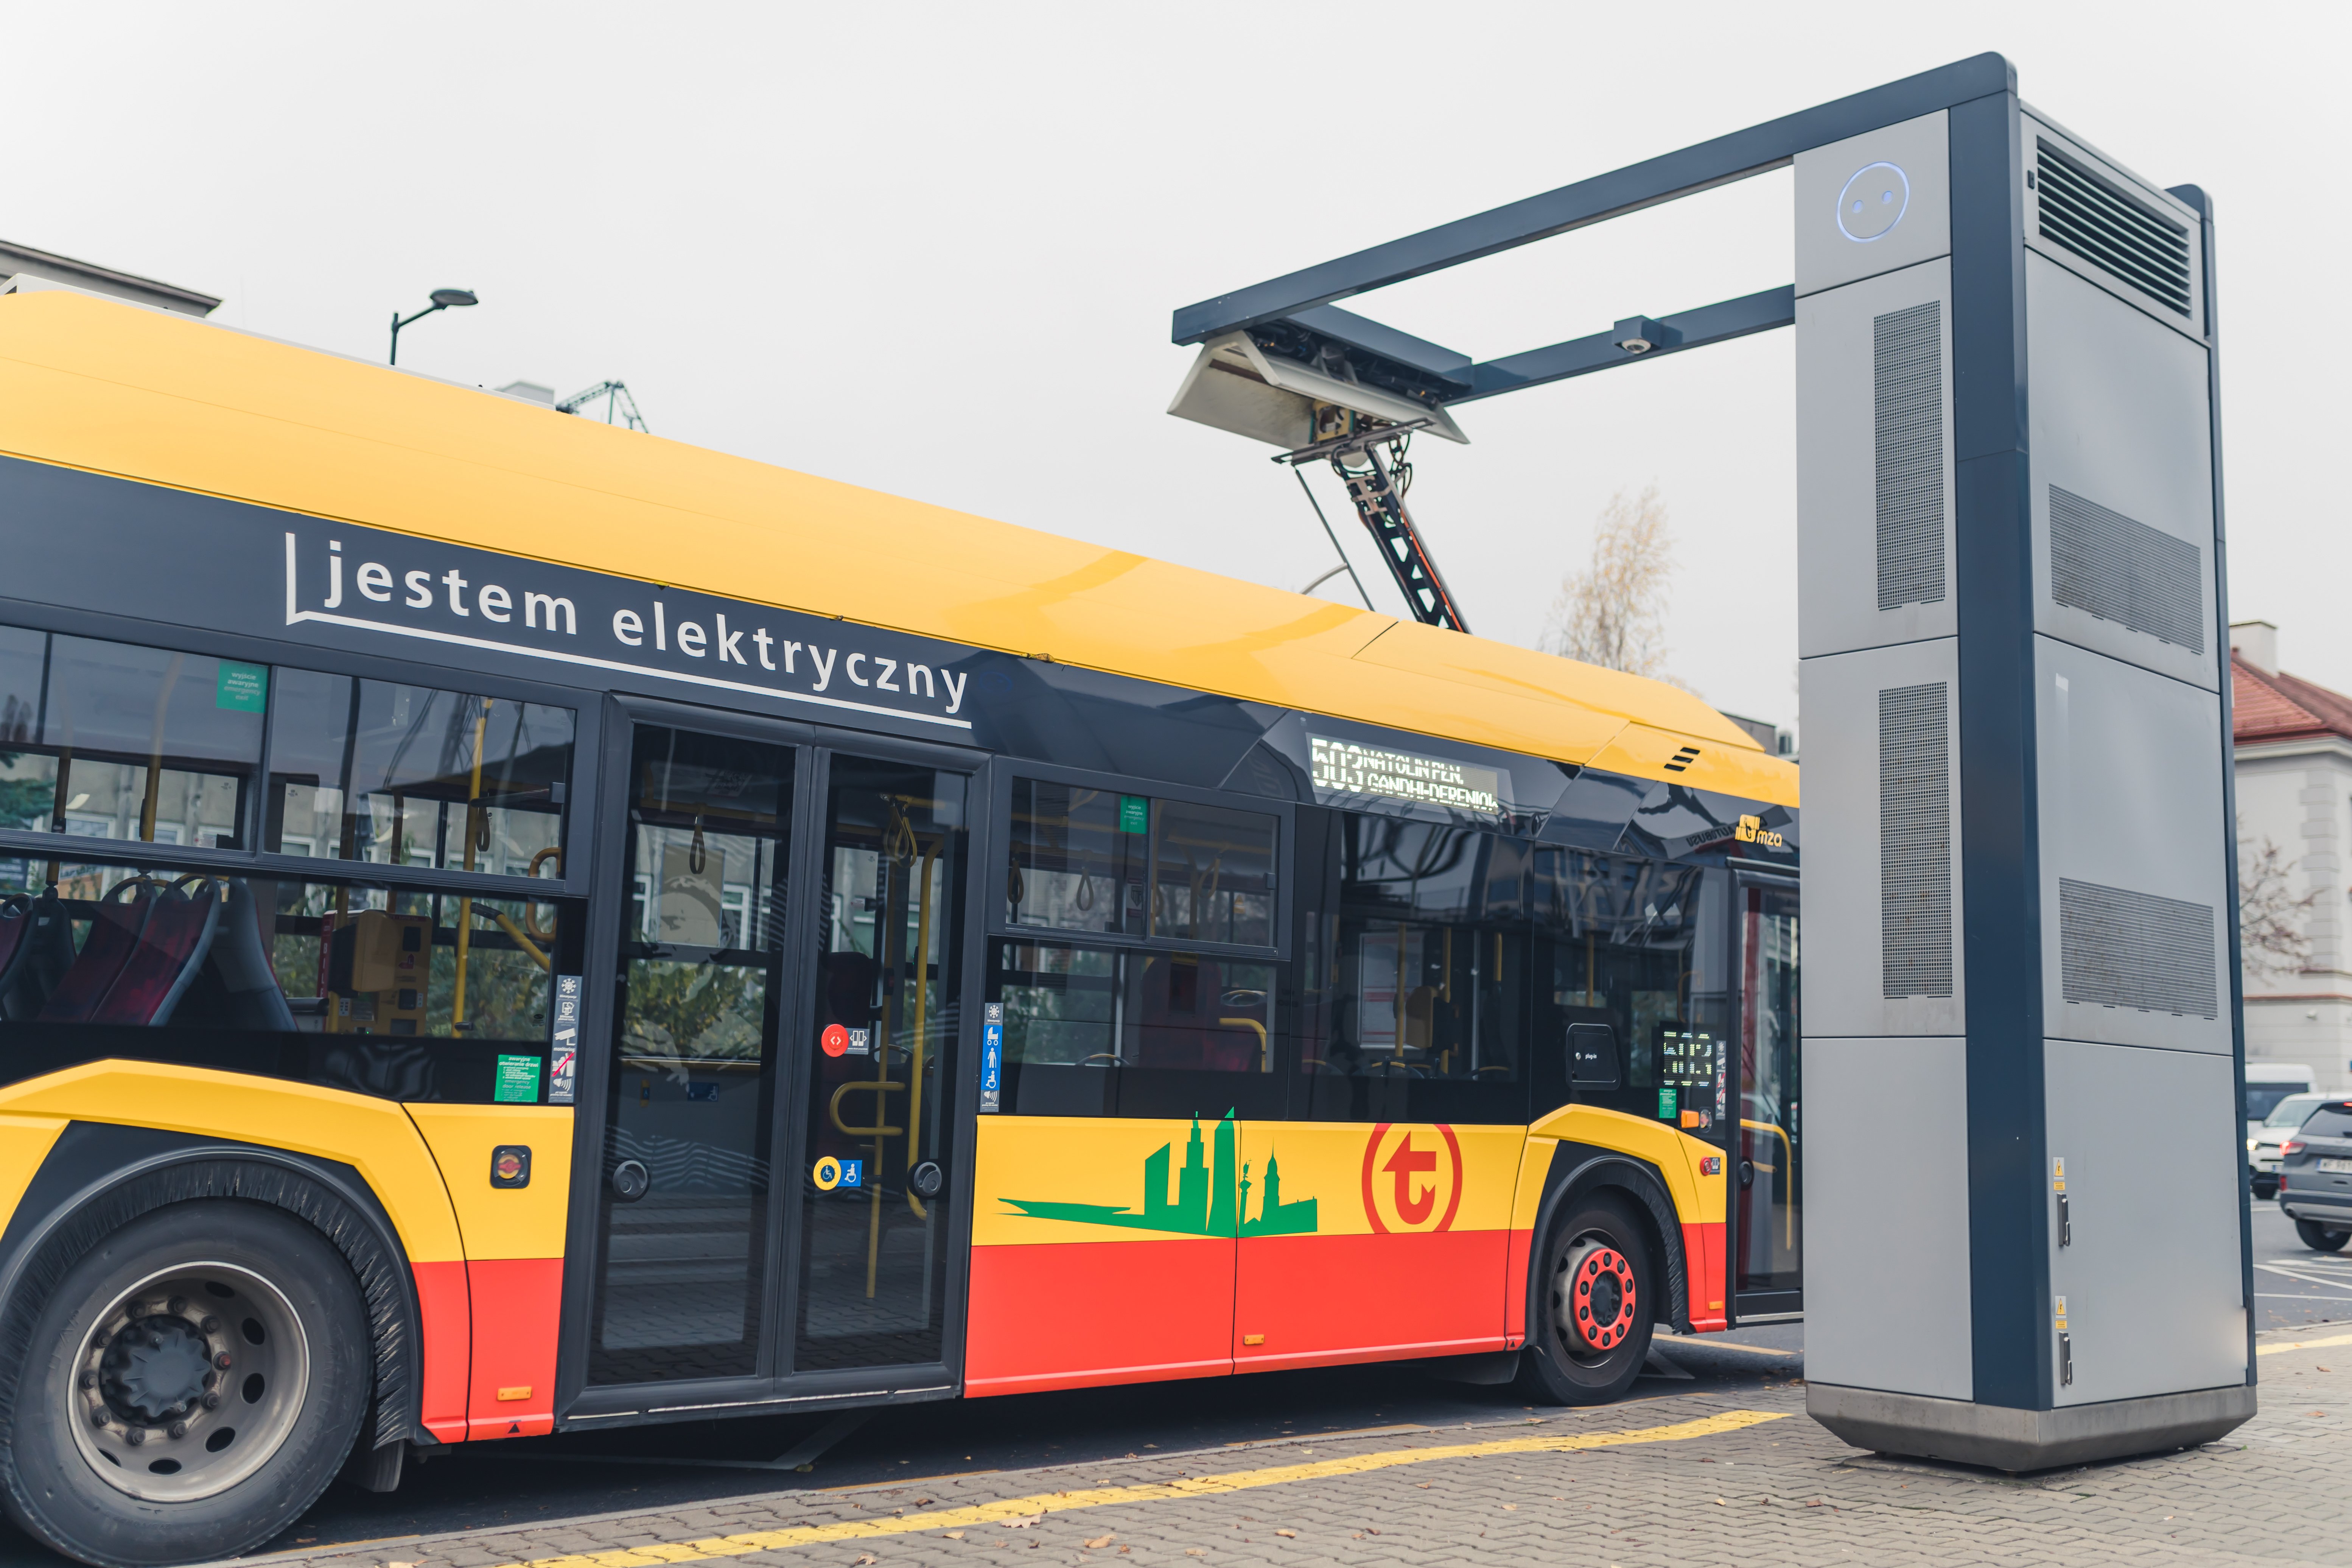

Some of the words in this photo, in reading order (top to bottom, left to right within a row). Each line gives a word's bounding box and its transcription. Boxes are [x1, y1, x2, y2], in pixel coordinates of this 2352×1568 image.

[324, 540, 577, 635] jestem
[613, 601, 968, 714] elektryczny
[227, 679, 258, 688] awaryjne
[224, 686, 261, 696] emergency
[1756, 830, 1782, 847] mza
